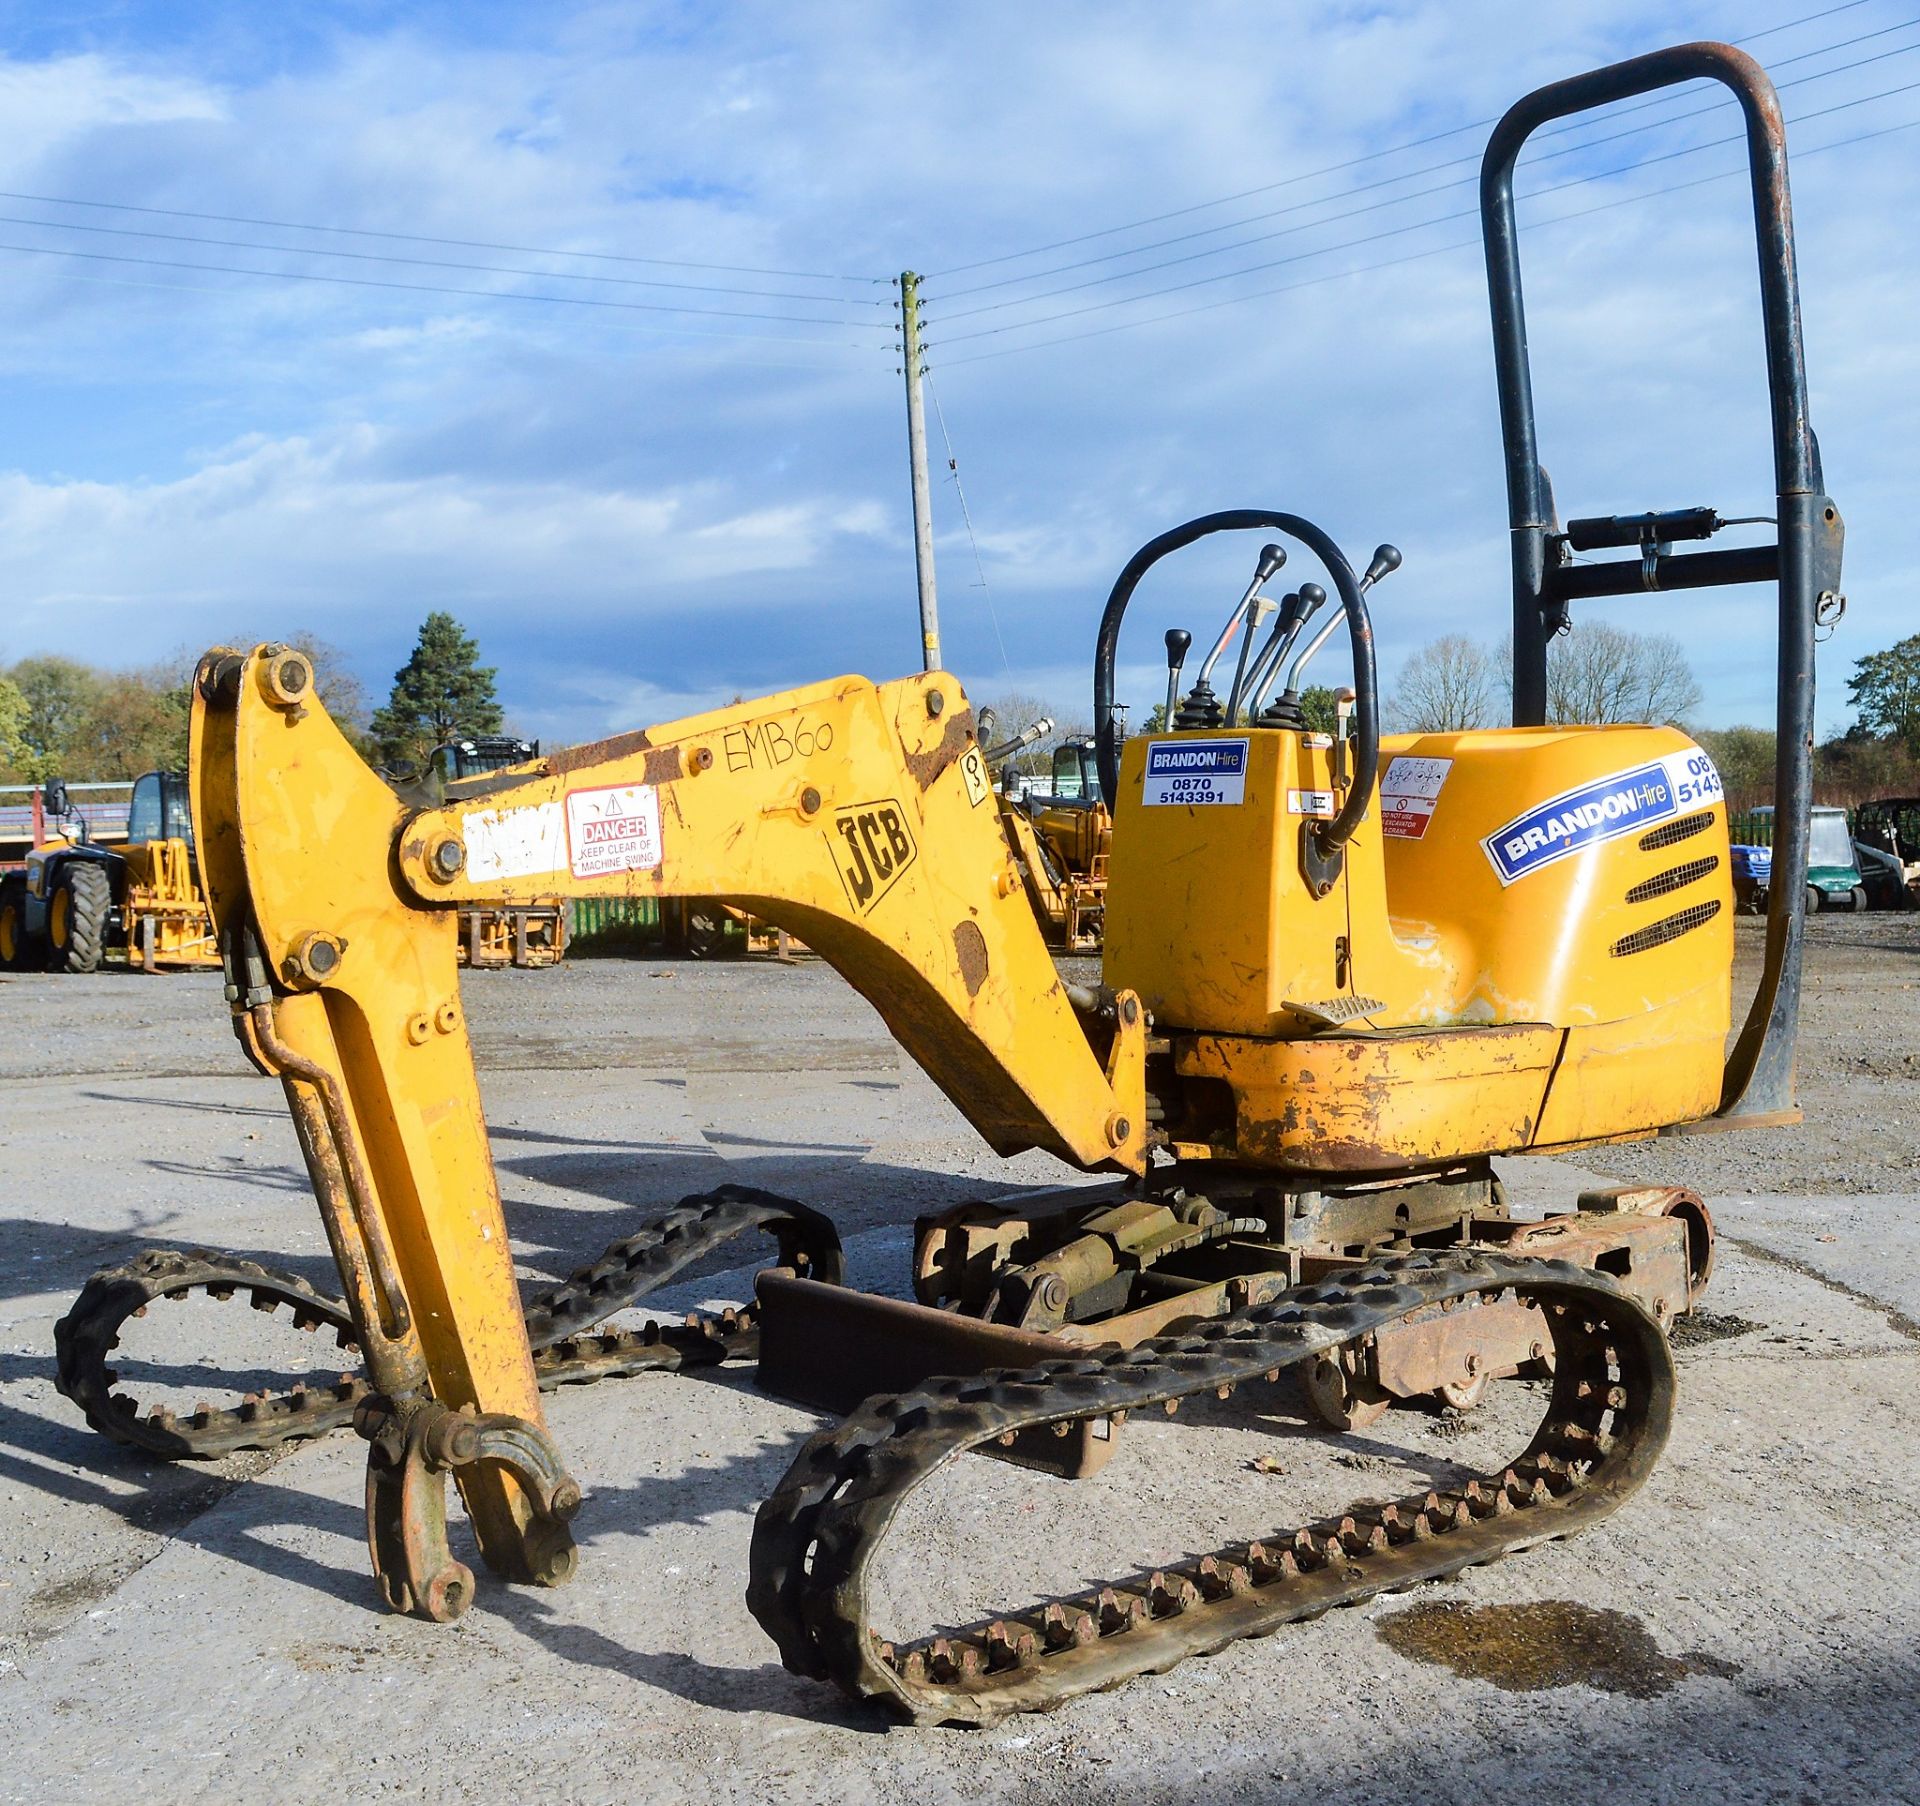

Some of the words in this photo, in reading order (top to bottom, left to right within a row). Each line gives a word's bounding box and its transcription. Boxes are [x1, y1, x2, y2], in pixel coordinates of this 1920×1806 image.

[723, 717, 833, 772] EMB60
[1172, 778, 1212, 790] 0870
[1160, 791, 1224, 803] 5143391
[584, 818, 646, 842] DANGER
[1385, 820, 1416, 828] EXCAVATOR
[581, 846, 604, 858] KEEP
[607, 841, 637, 855] CLEAR
[639, 839, 652, 850] OF
[836, 808, 910, 908] JCB
[581, 857, 622, 872] MACHINE
[624, 852, 654, 865] SWING
